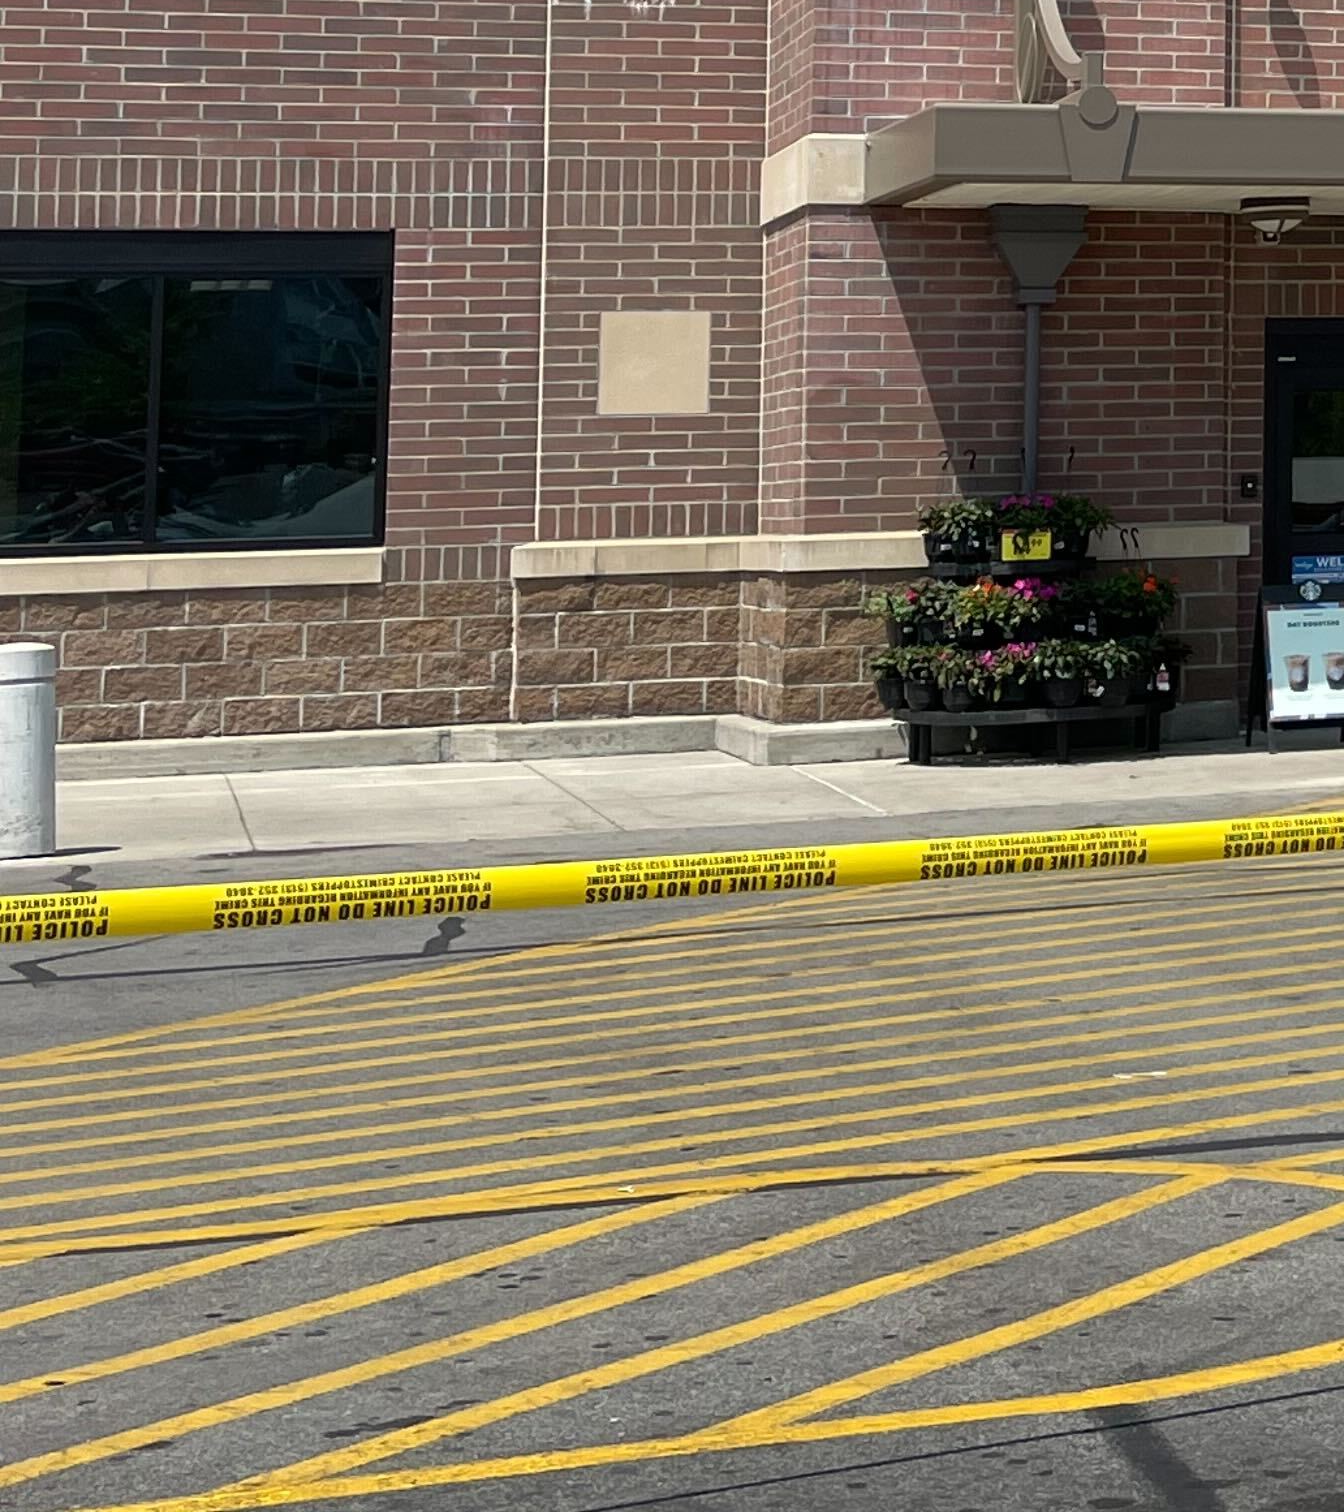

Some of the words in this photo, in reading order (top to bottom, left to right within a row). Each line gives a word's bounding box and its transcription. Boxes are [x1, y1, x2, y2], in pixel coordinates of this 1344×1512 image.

[1223, 841, 1275, 858] CROSS
[1280, 838, 1310, 854] NOT
[1316, 836, 1336, 851] DO
[1021, 856, 1043, 871] DO
[1049, 853, 1083, 869] LINE
[1089, 849, 1145, 866] POLICE
[920, 861, 977, 879] CROSS
[982, 859, 1015, 874] NOT
[460, 882, 480, 892] YOU
[698, 878, 722, 894] DO
[728, 875, 766, 892] LINE
[773, 870, 835, 889] POLICE
[339, 888, 408, 901] INFORMATION
[412, 886, 431, 896] ANY
[434, 884, 458, 894] HAVE
[585, 884, 648, 903] CROSS
[654, 881, 690, 898] NOT
[214, 899, 248, 911] CRIME
[251, 897, 276, 908] THIS
[278, 893, 337, 906] REGARDING
[422, 893, 491, 913] POLICE
[45, 909, 71, 920] HAVE
[74, 907, 95, 918] YOU
[290, 905, 330, 923] NOT
[338, 903, 365, 919] DO
[372, 899, 415, 917] LINE
[19, 911, 41, 922] ANY
[213, 909, 283, 929] CROSS
[32, 919, 109, 941] POLICE
